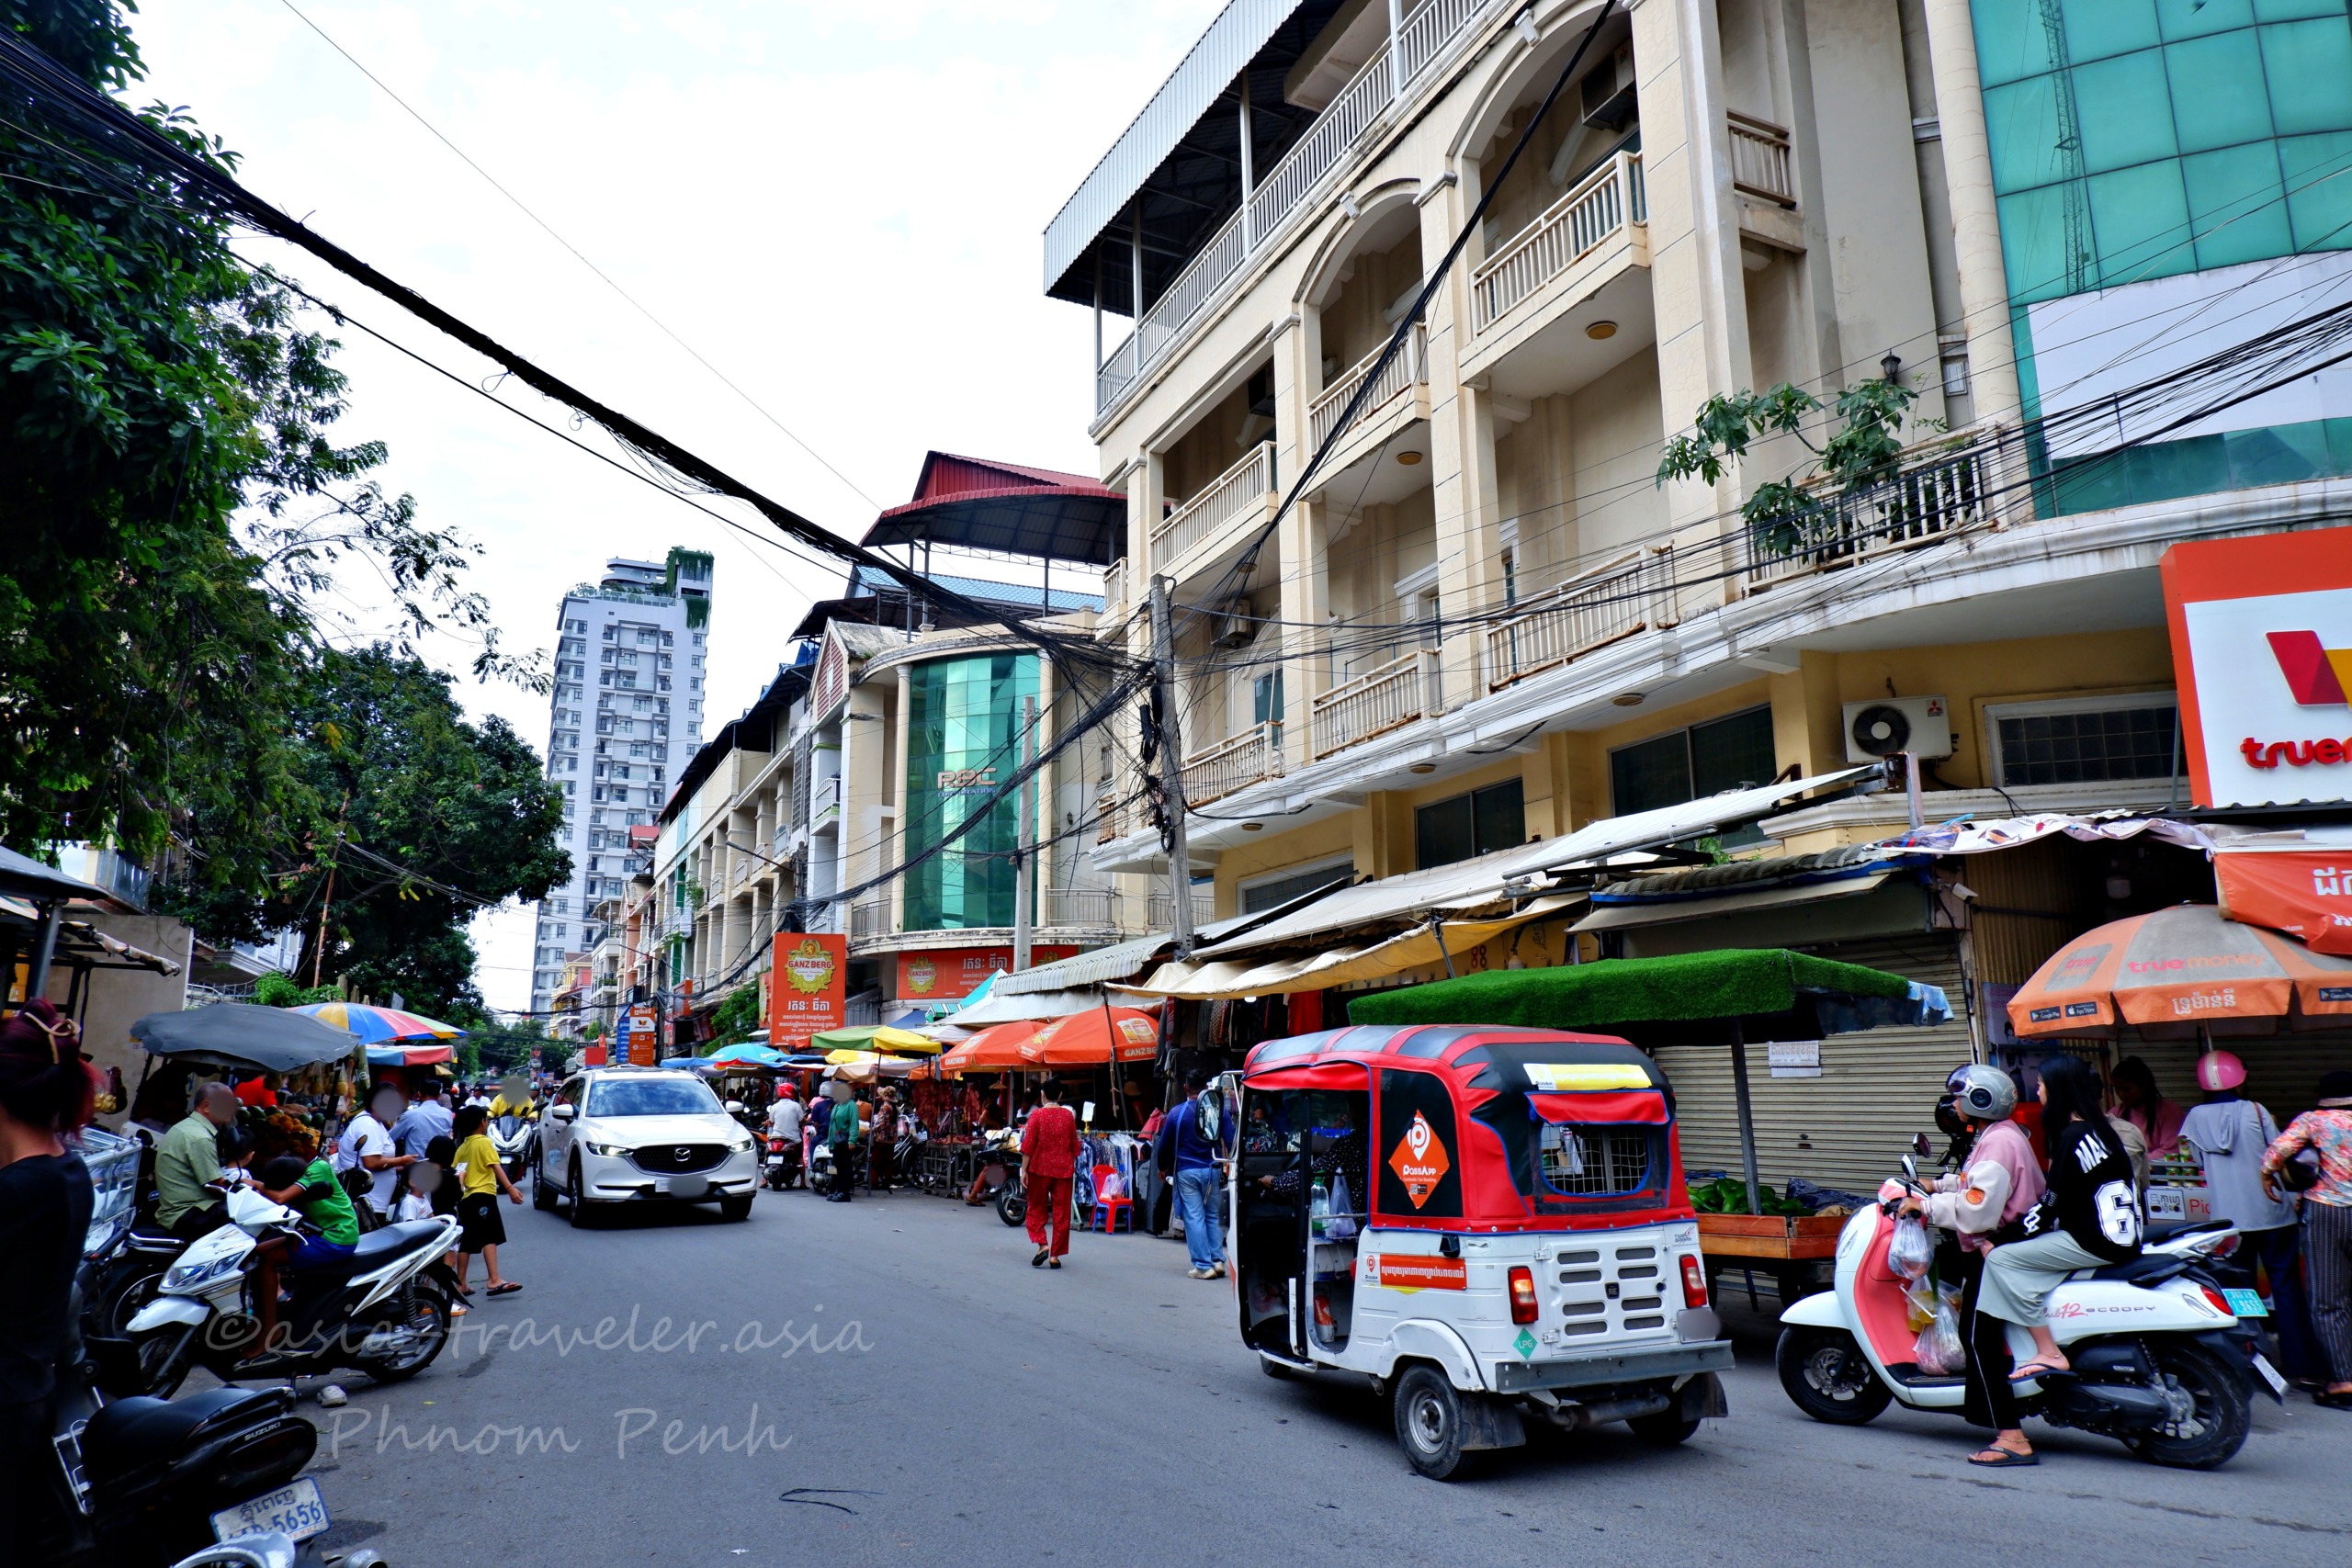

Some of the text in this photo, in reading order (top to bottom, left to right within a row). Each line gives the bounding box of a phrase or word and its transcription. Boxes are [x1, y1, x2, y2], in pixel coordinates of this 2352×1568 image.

[2240, 737, 2352, 769] true
[1518, 1339, 1533, 1349] LPG
[243, 1421, 281, 1441] SUZUKI
